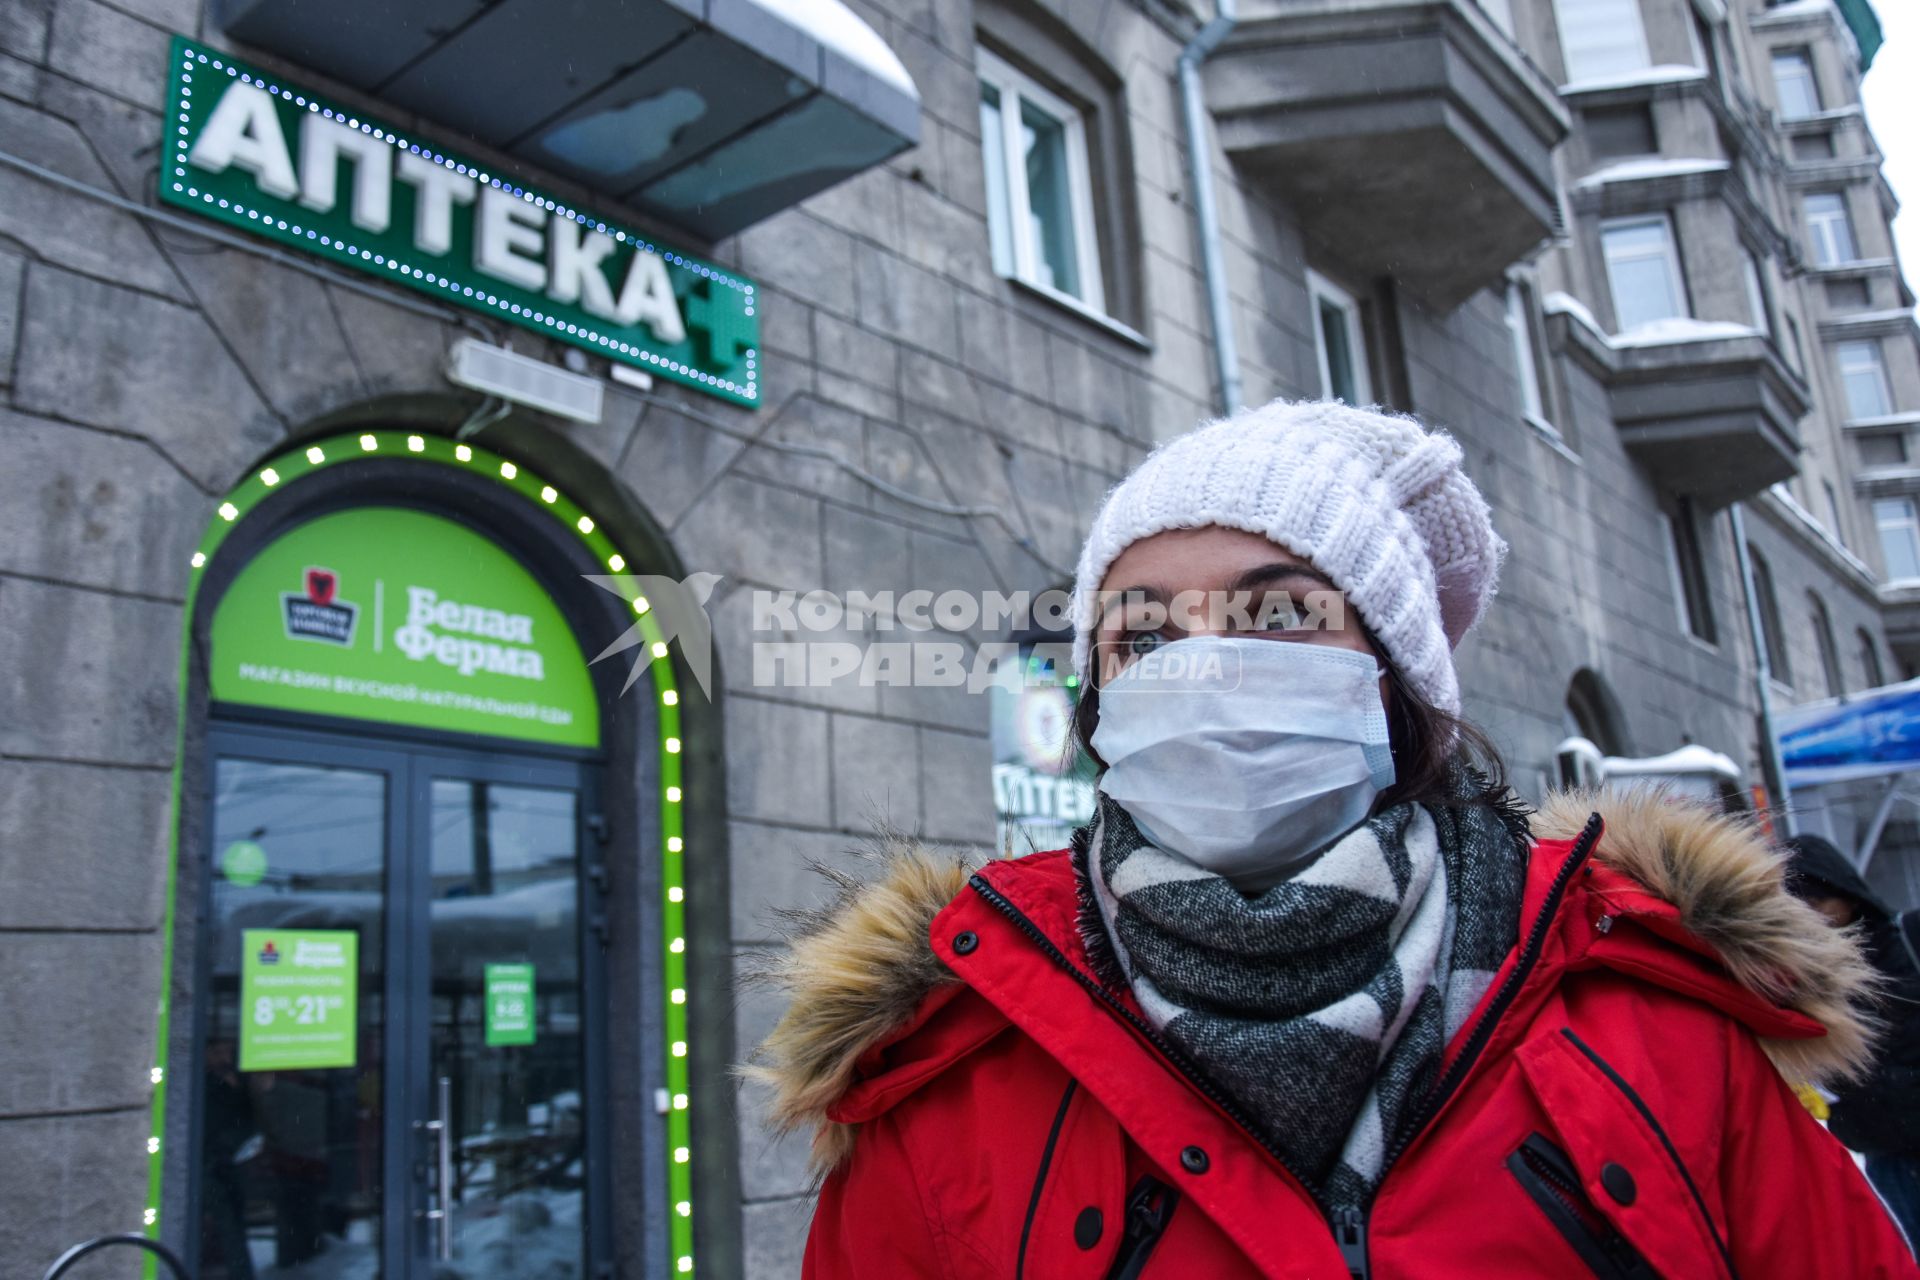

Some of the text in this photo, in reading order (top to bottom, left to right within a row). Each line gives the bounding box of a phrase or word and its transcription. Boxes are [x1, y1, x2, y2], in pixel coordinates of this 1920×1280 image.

[190, 80, 687, 344] АПТЕКА
[406, 585, 534, 645] Белая
[394, 625, 545, 681] Ферма
[239, 662, 332, 692] МАГАЗИН
[333, 674, 418, 704] ВКУСНОЙ
